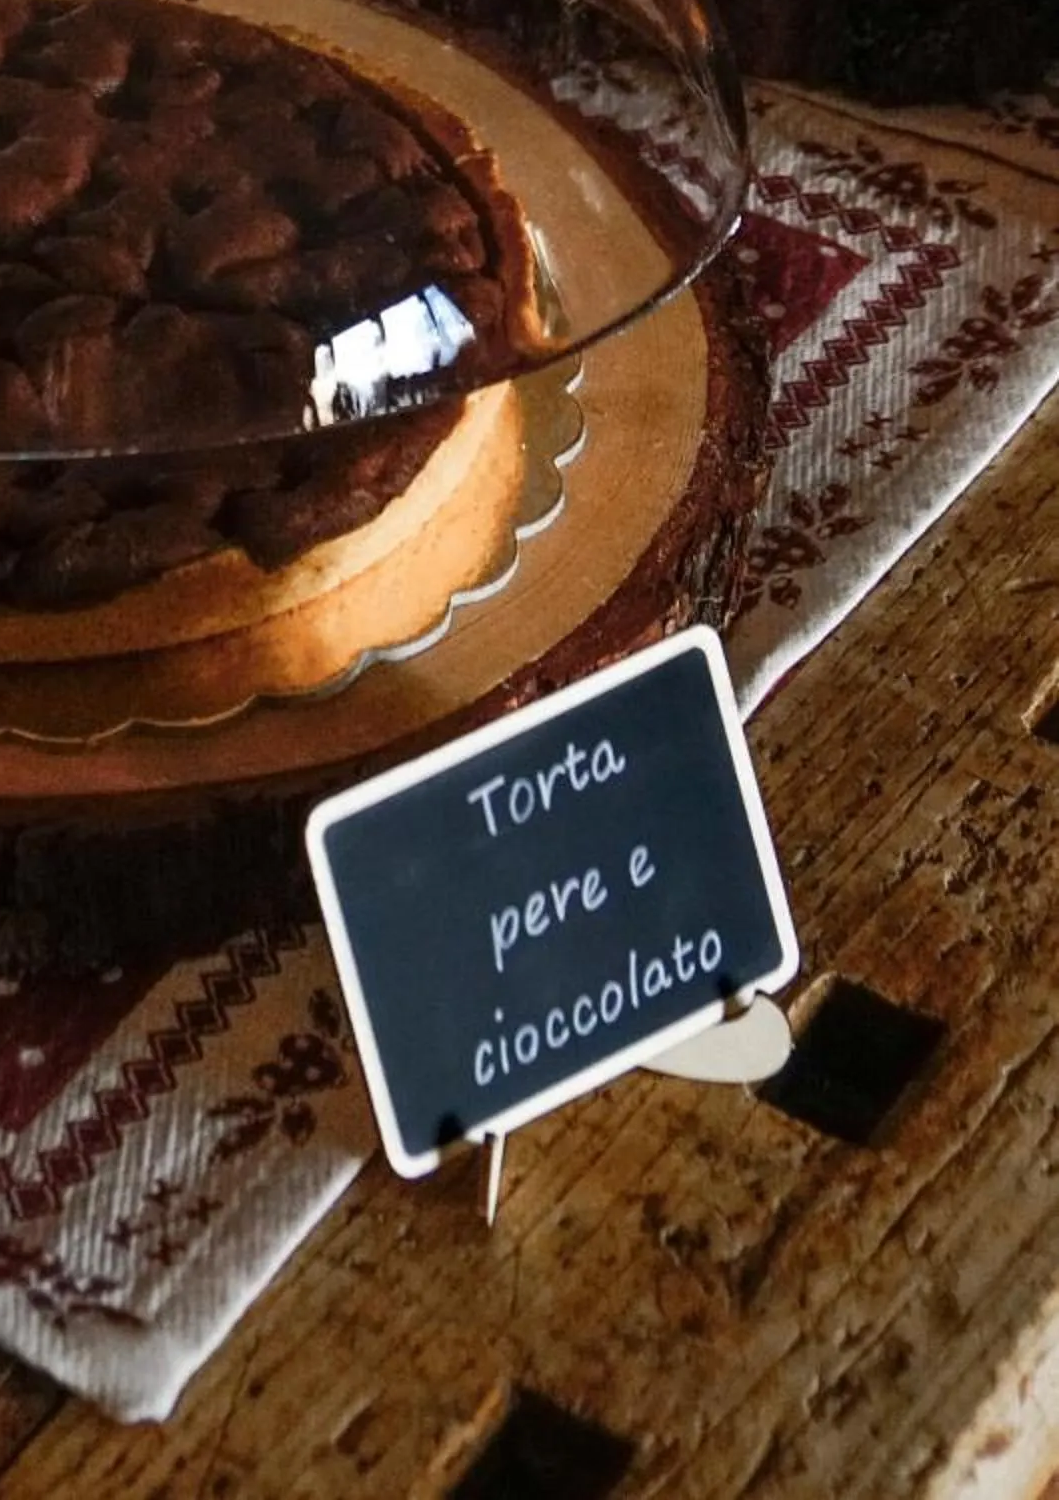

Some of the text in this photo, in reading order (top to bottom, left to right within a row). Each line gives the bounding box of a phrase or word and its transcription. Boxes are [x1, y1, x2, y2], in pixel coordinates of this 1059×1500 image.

[467, 739, 626, 837] Torta
[489, 845, 656, 973] pere e
[473, 928, 723, 1086] cioccolato
